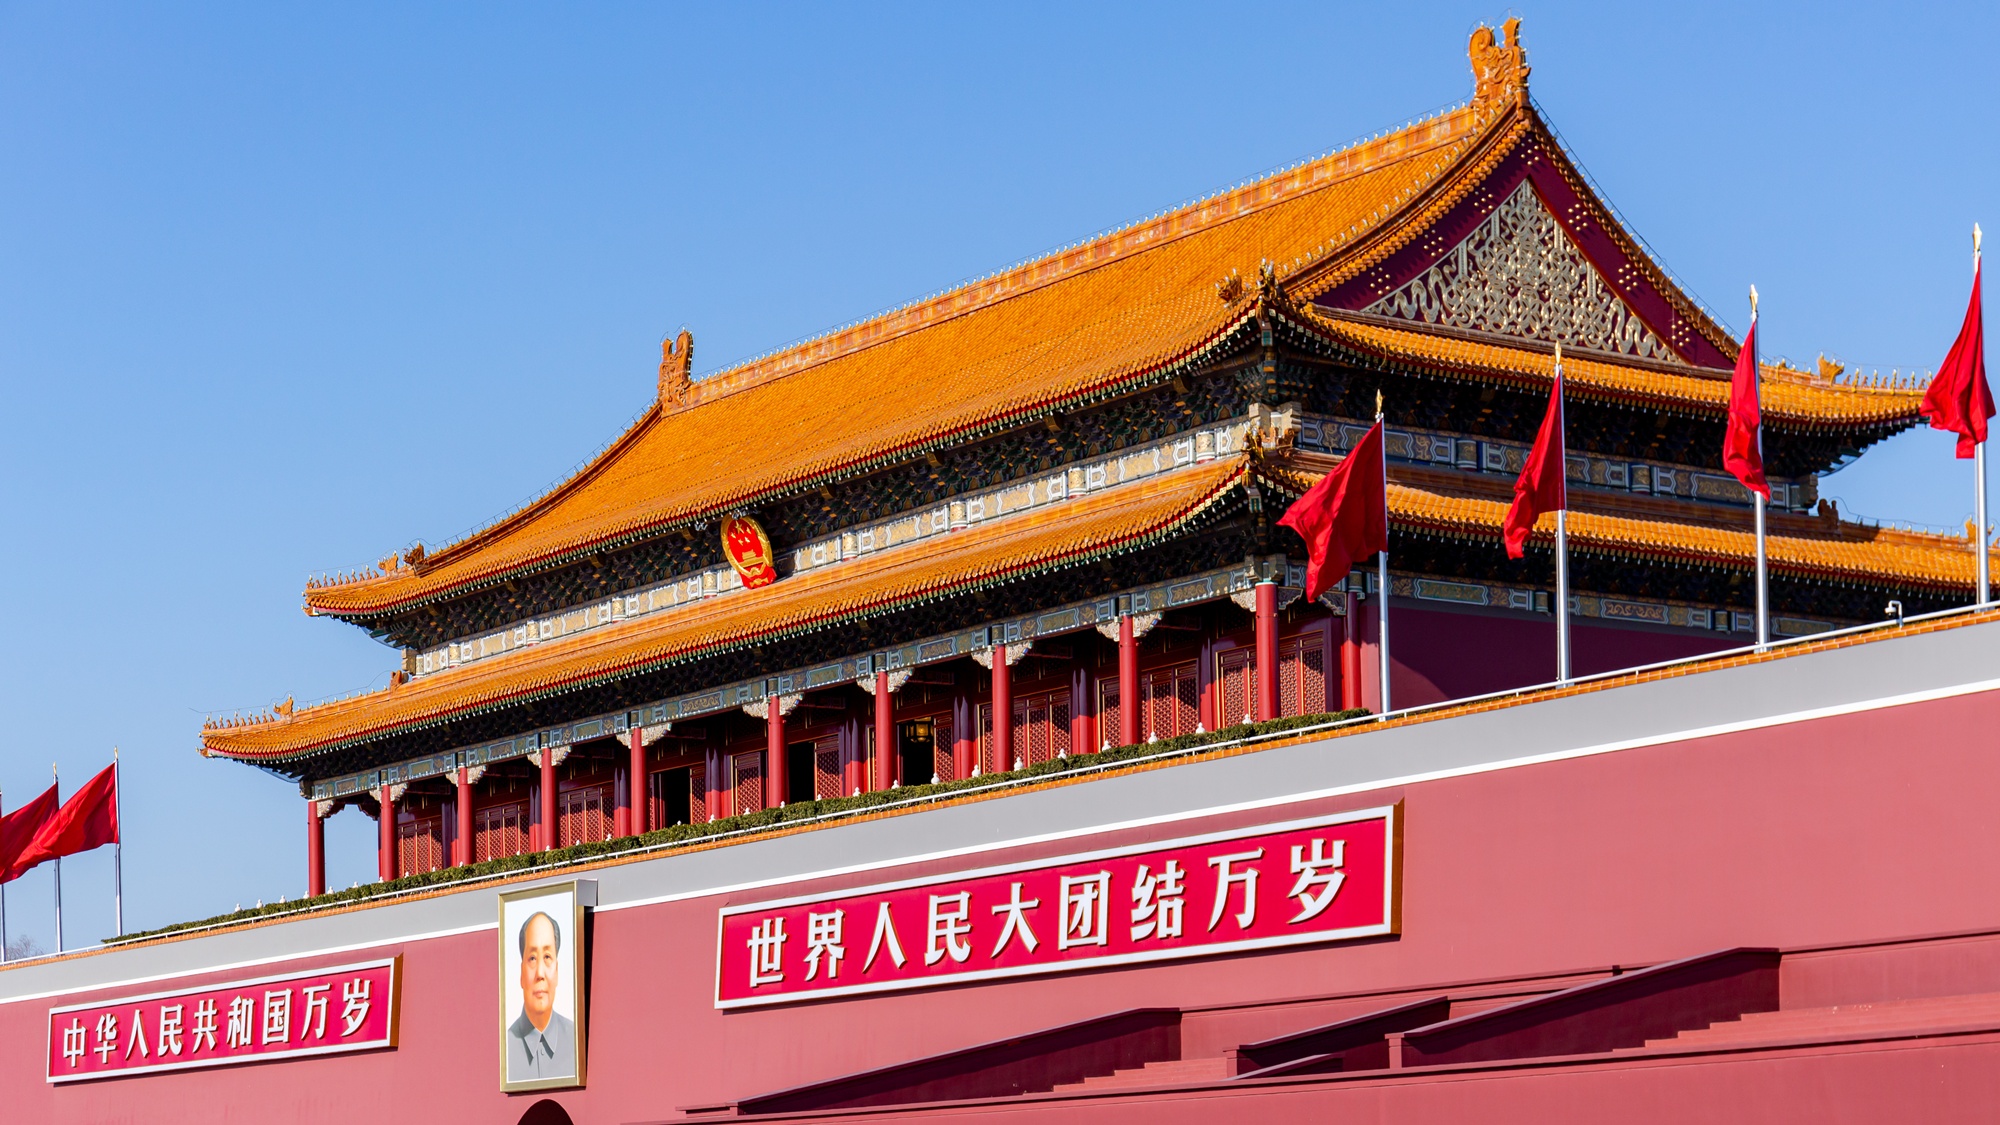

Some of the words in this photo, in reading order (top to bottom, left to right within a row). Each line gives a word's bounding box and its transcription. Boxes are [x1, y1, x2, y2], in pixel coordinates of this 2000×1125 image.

[746, 838, 1346, 988] 世界人民大团结万岁
[62, 977, 371, 1068] 中华人民共和国万岁
